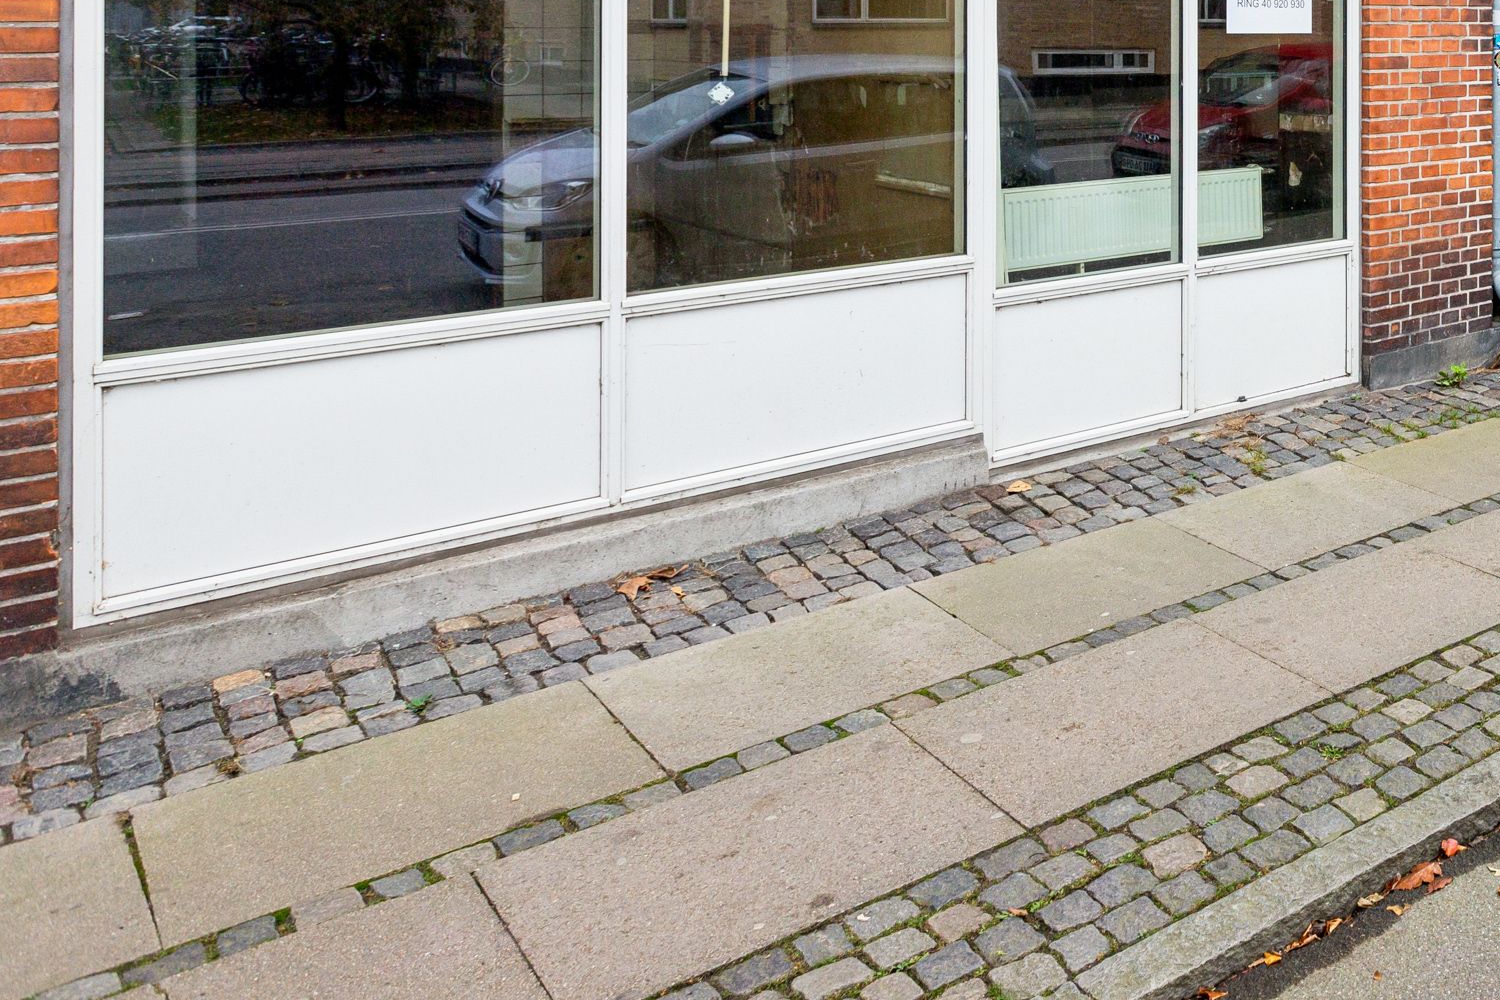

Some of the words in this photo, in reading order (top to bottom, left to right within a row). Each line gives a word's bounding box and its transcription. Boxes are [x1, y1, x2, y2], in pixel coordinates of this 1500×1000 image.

[1261, 0, 1272, 9] 40
[1273, 0, 1289, 9] 920
[1290, 0, 1305, 9] 930
